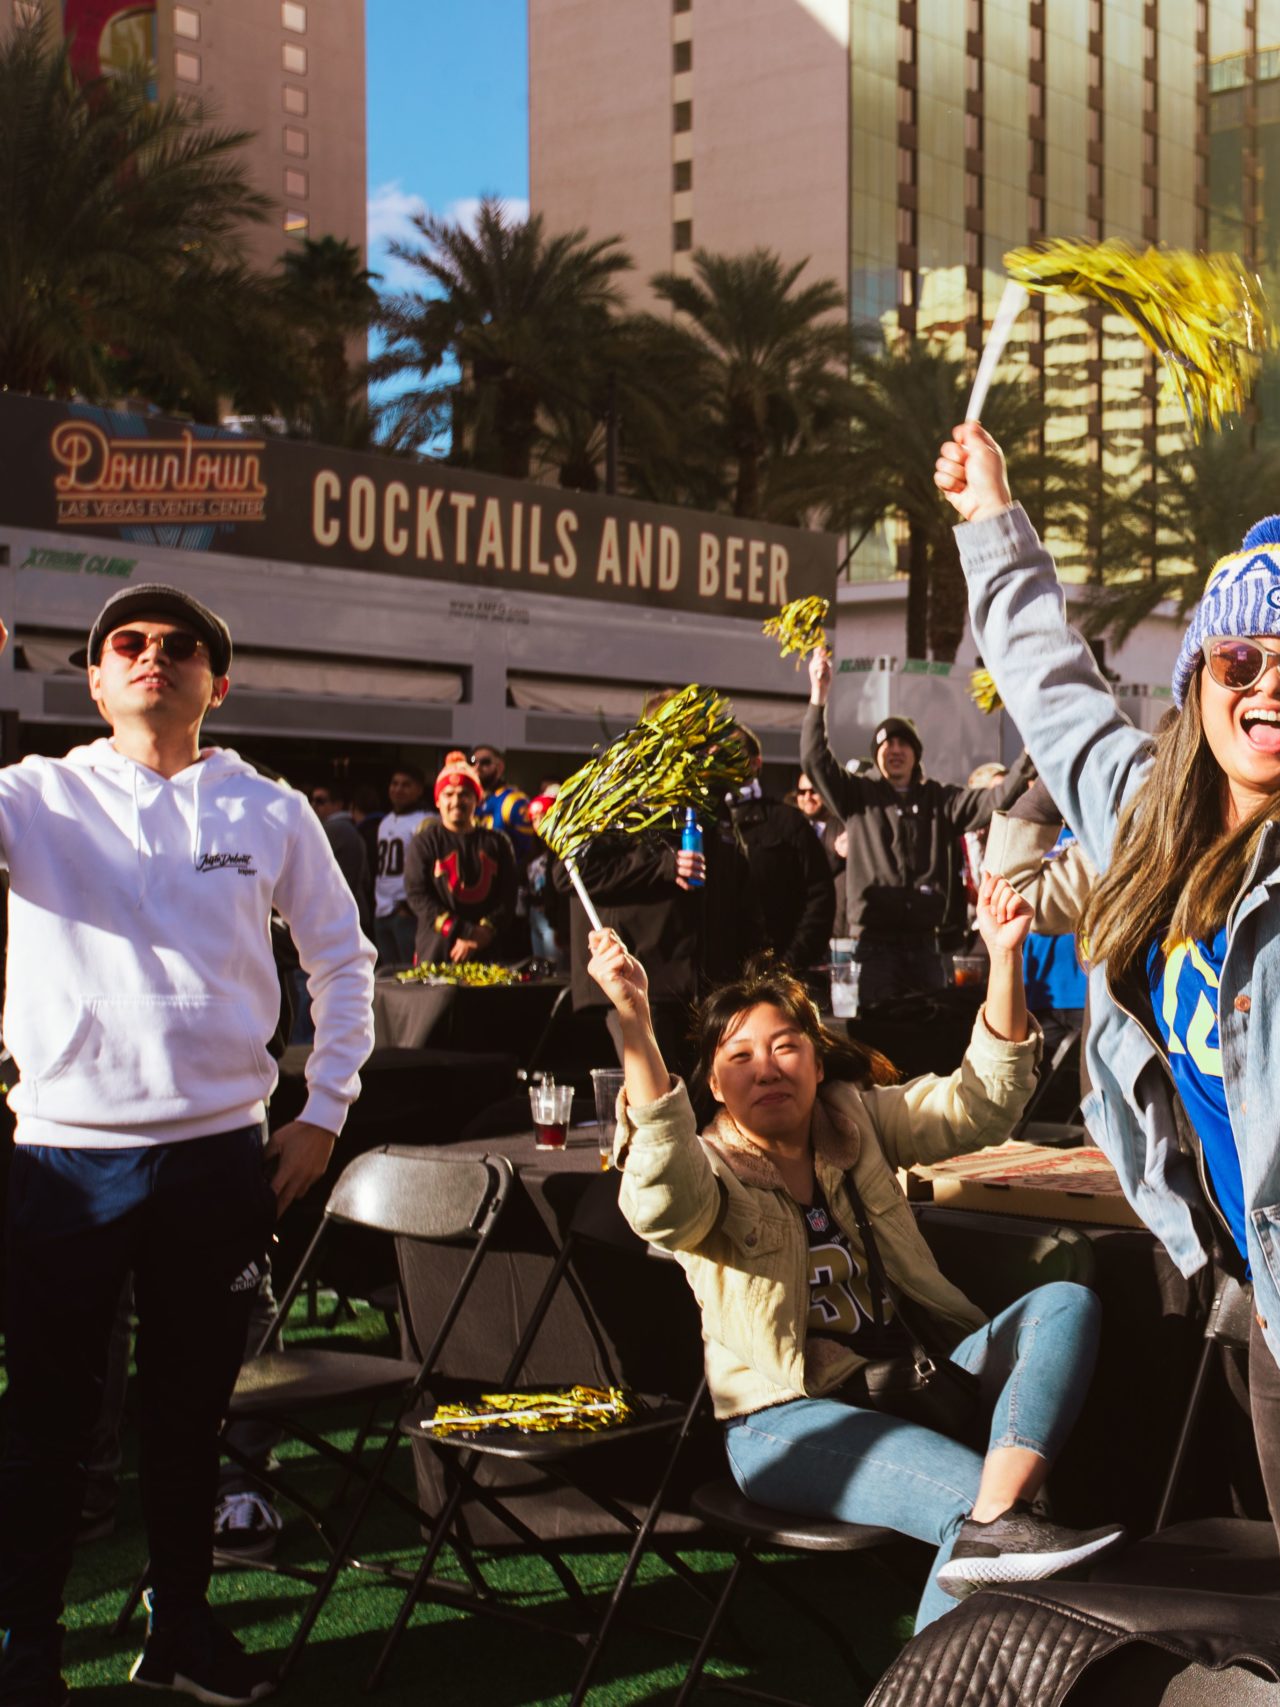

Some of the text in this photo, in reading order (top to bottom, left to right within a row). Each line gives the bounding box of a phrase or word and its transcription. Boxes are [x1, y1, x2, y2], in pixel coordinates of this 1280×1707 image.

[52, 420, 267, 496] Downtown
[58, 500, 264, 517] LAS VEGAS EVENTS CENTER
[312, 469, 788, 605] COCKTAILS AND BEER
